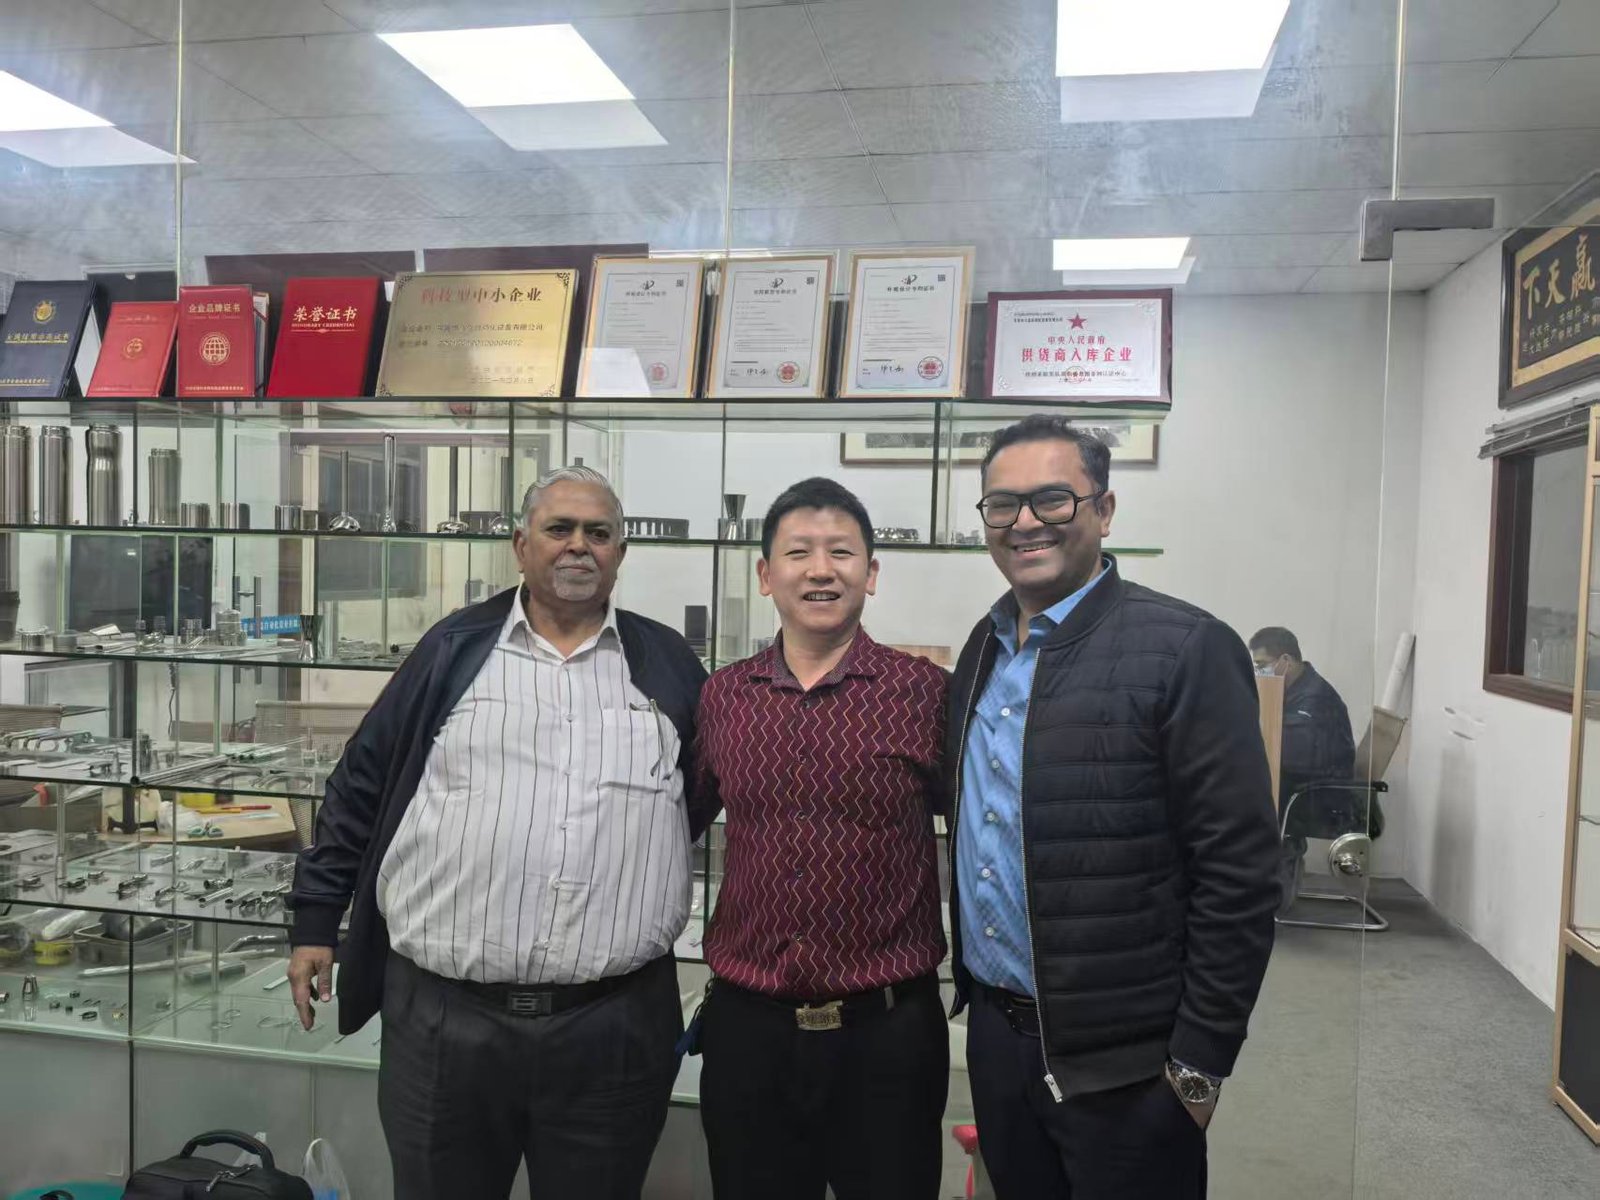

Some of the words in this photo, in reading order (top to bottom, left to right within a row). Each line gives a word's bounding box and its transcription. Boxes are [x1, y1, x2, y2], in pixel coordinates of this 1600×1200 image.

[421, 286, 542, 304] 科技型中小企业
[188, 303, 241, 313] 企业品牌证书
[292, 306, 358, 322] 荣誉证书
[1047, 335, 1106, 345] 中央人民政府
[1021, 347, 1132, 362] 供货商入库企业
